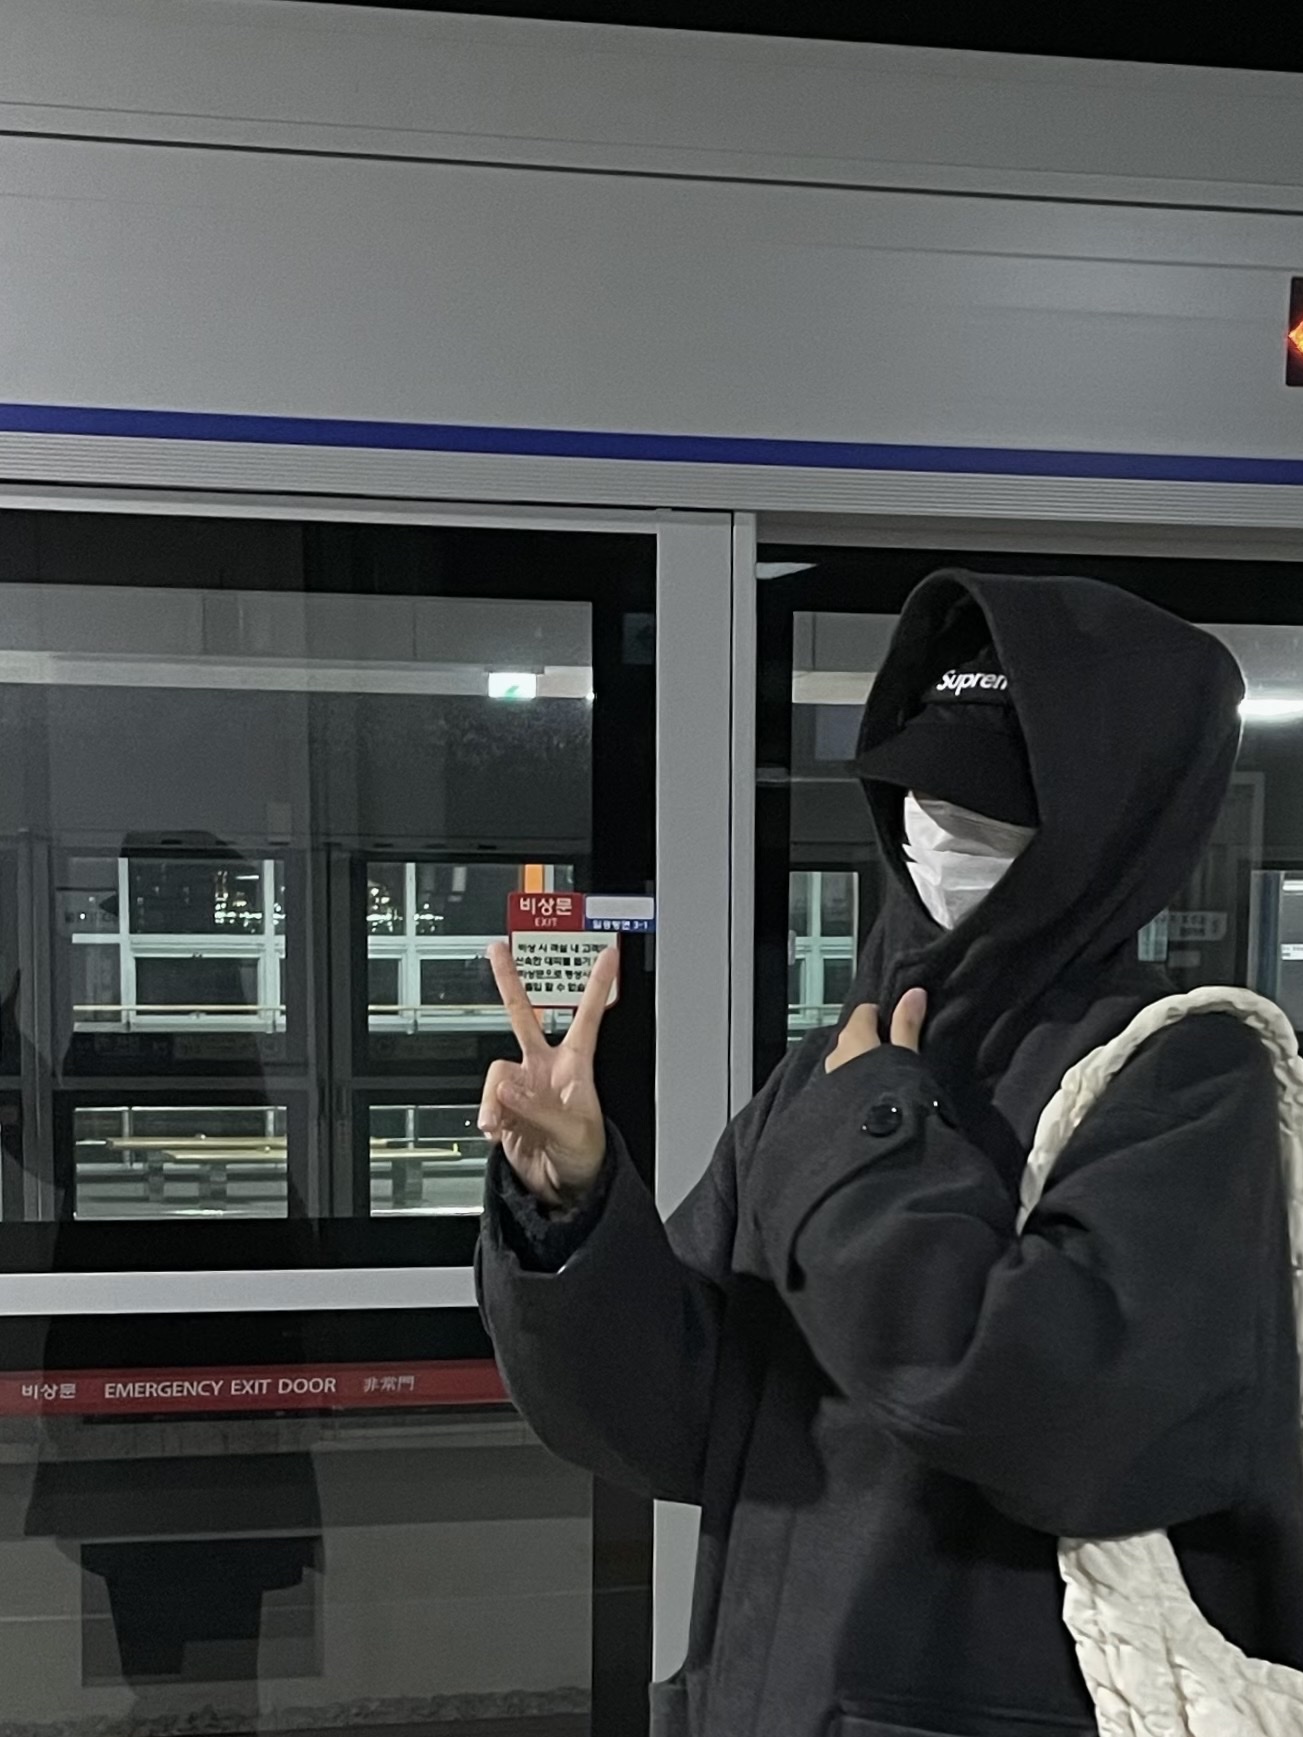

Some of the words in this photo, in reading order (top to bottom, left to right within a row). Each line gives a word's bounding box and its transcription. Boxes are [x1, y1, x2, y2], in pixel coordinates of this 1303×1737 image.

[520, 897, 573, 916] 비상문
[534, 917, 559, 927] EXIT
[21, 1382, 76, 1400] 비상문
[104, 1379, 224, 1399] EMERGENCY
[230, 1378, 273, 1396] EXIT
[277, 1377, 337, 1395] DOOR
[362, 1374, 415, 1393] 非常門
